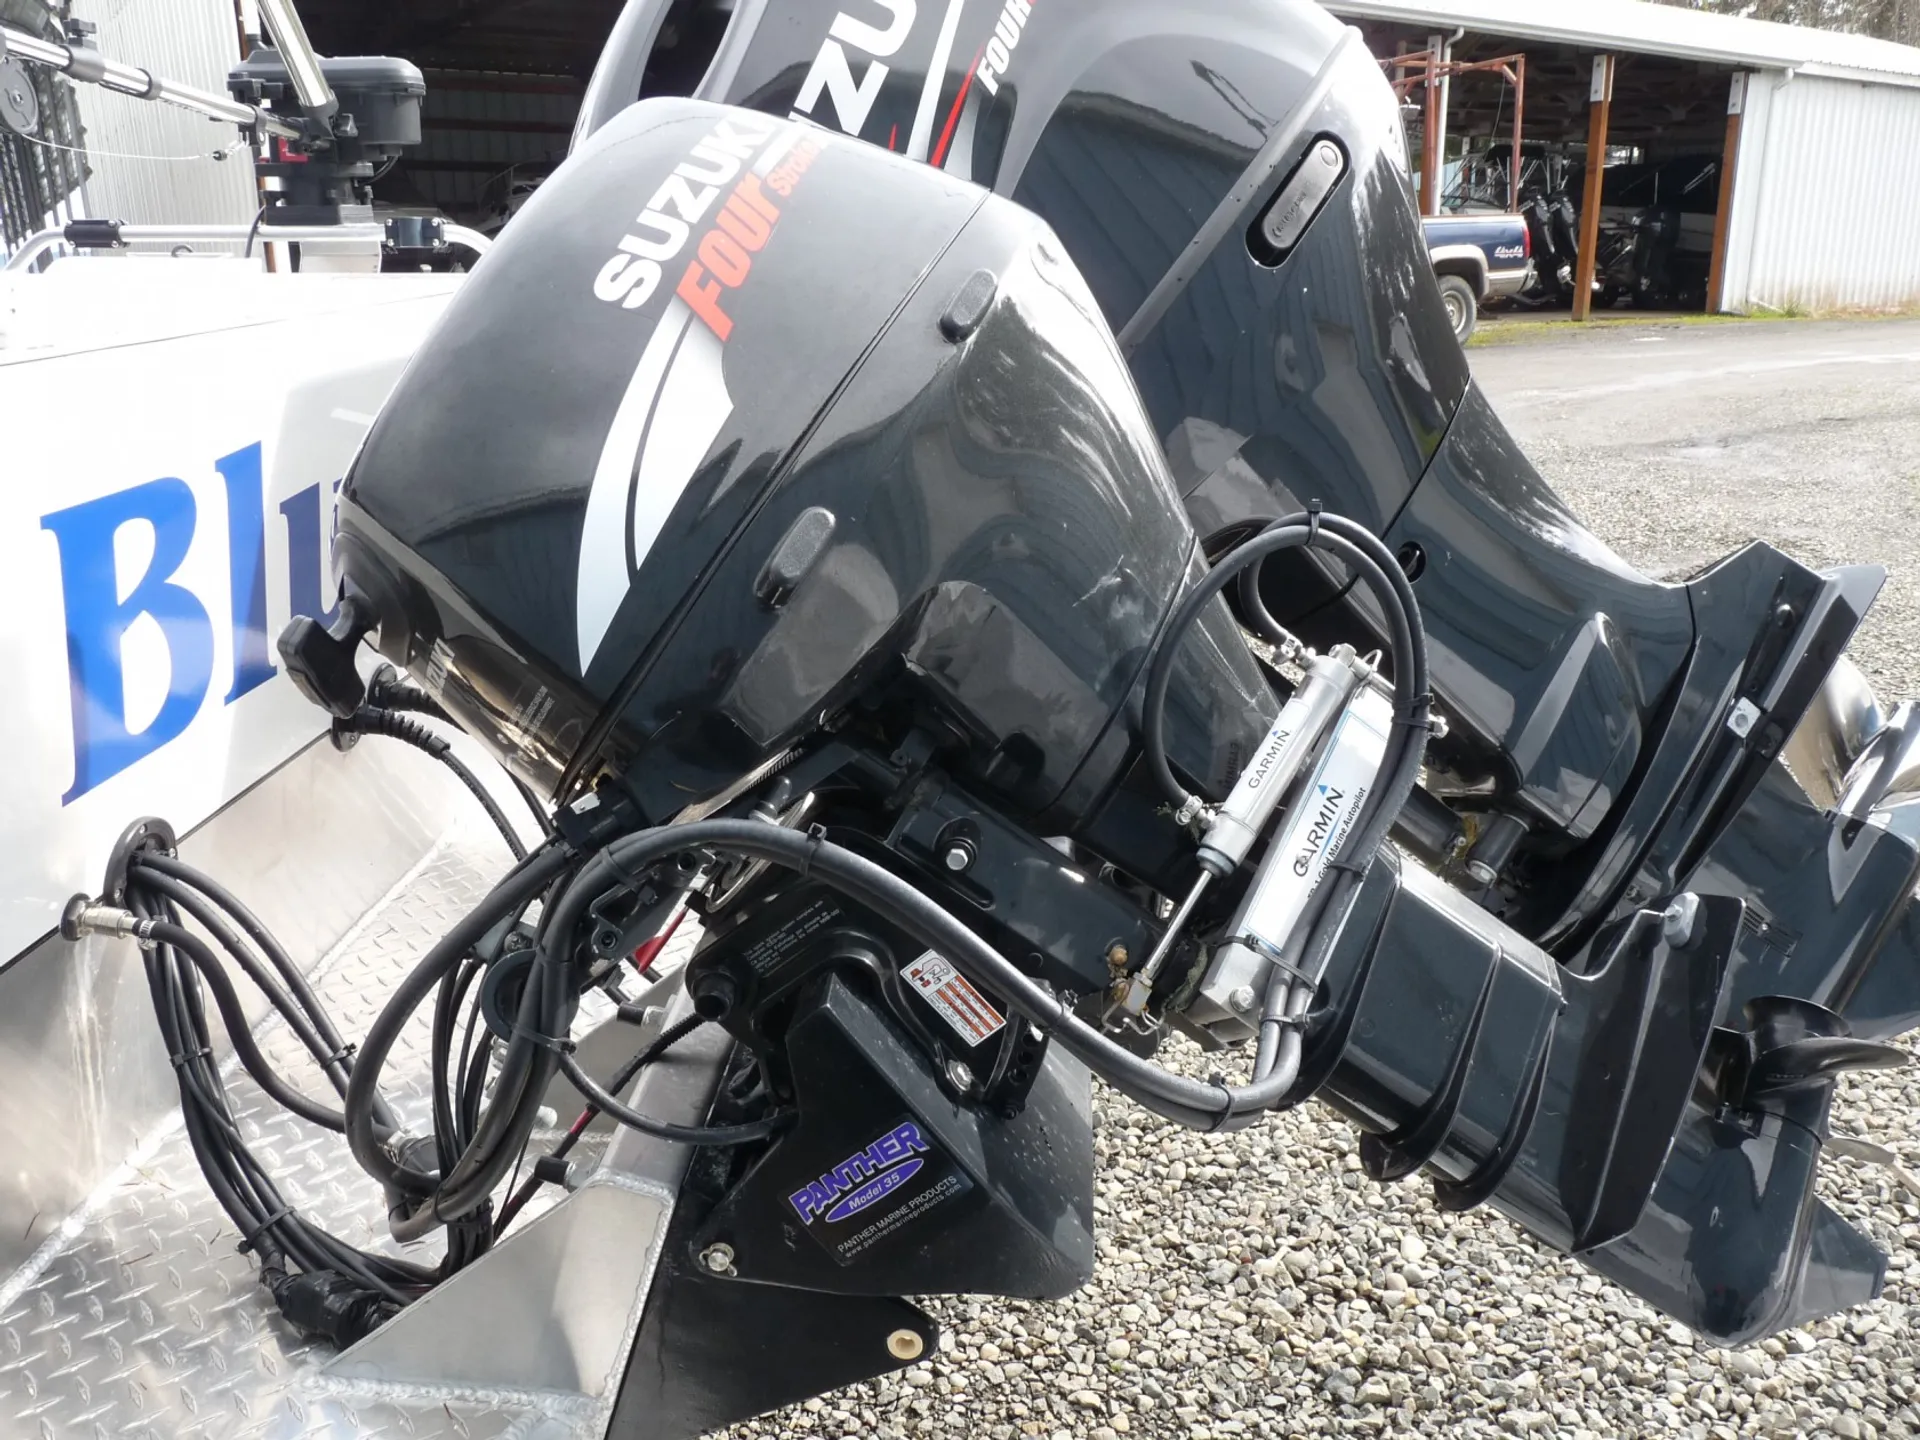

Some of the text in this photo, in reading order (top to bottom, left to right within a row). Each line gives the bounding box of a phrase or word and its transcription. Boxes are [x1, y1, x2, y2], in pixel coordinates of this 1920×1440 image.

[593, 112, 783, 309] SUZUKI
[1494, 245, 1524, 258] 4x4
[1248, 730, 1290, 789] GARMIN
[1293, 787, 1344, 877] GARMIN
[1328, 828, 1347, 862] Marine
[1345, 787, 1367, 831] Autopilot
[788, 1122, 930, 1225] PANTHER
[848, 1172, 901, 1210] Model 35
[837, 1175, 957, 1253] PANTHER MARINE PRODUCTS
[845, 1183, 962, 1258] www.panthermarineproducts.com
